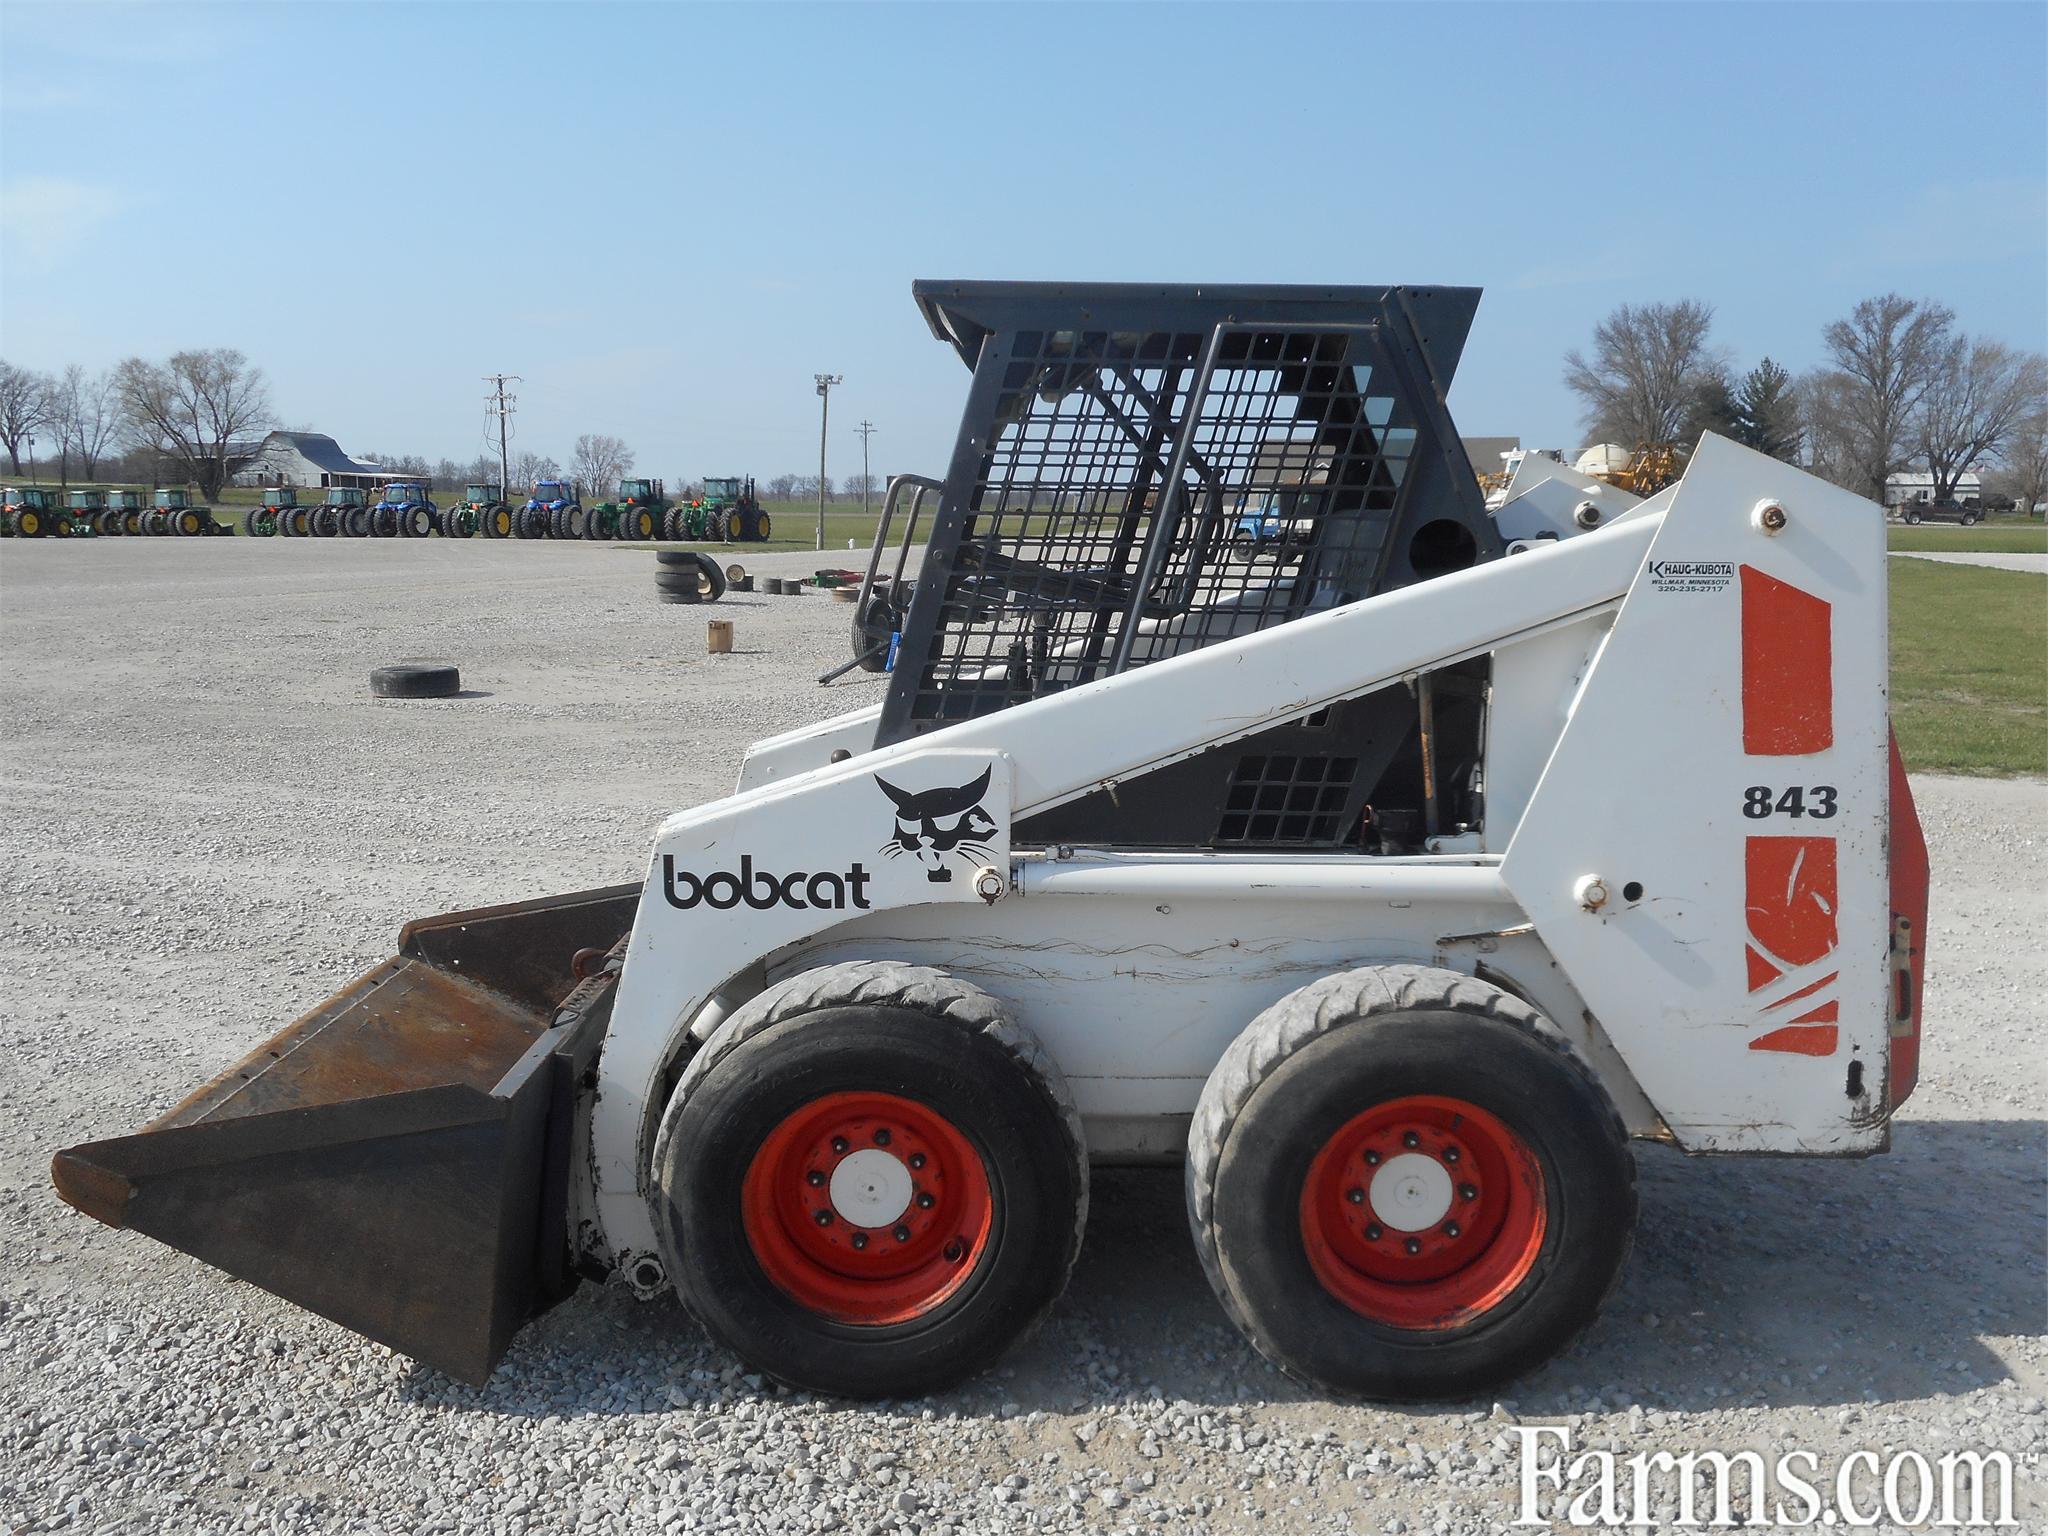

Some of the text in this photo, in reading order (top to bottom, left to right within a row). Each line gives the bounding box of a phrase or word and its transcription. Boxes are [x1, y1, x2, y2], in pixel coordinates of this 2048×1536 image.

[1664, 564, 1732, 575] HAUG-KUBOTA
[1743, 786, 1838, 818] 843
[663, 855, 870, 909] bobcat
